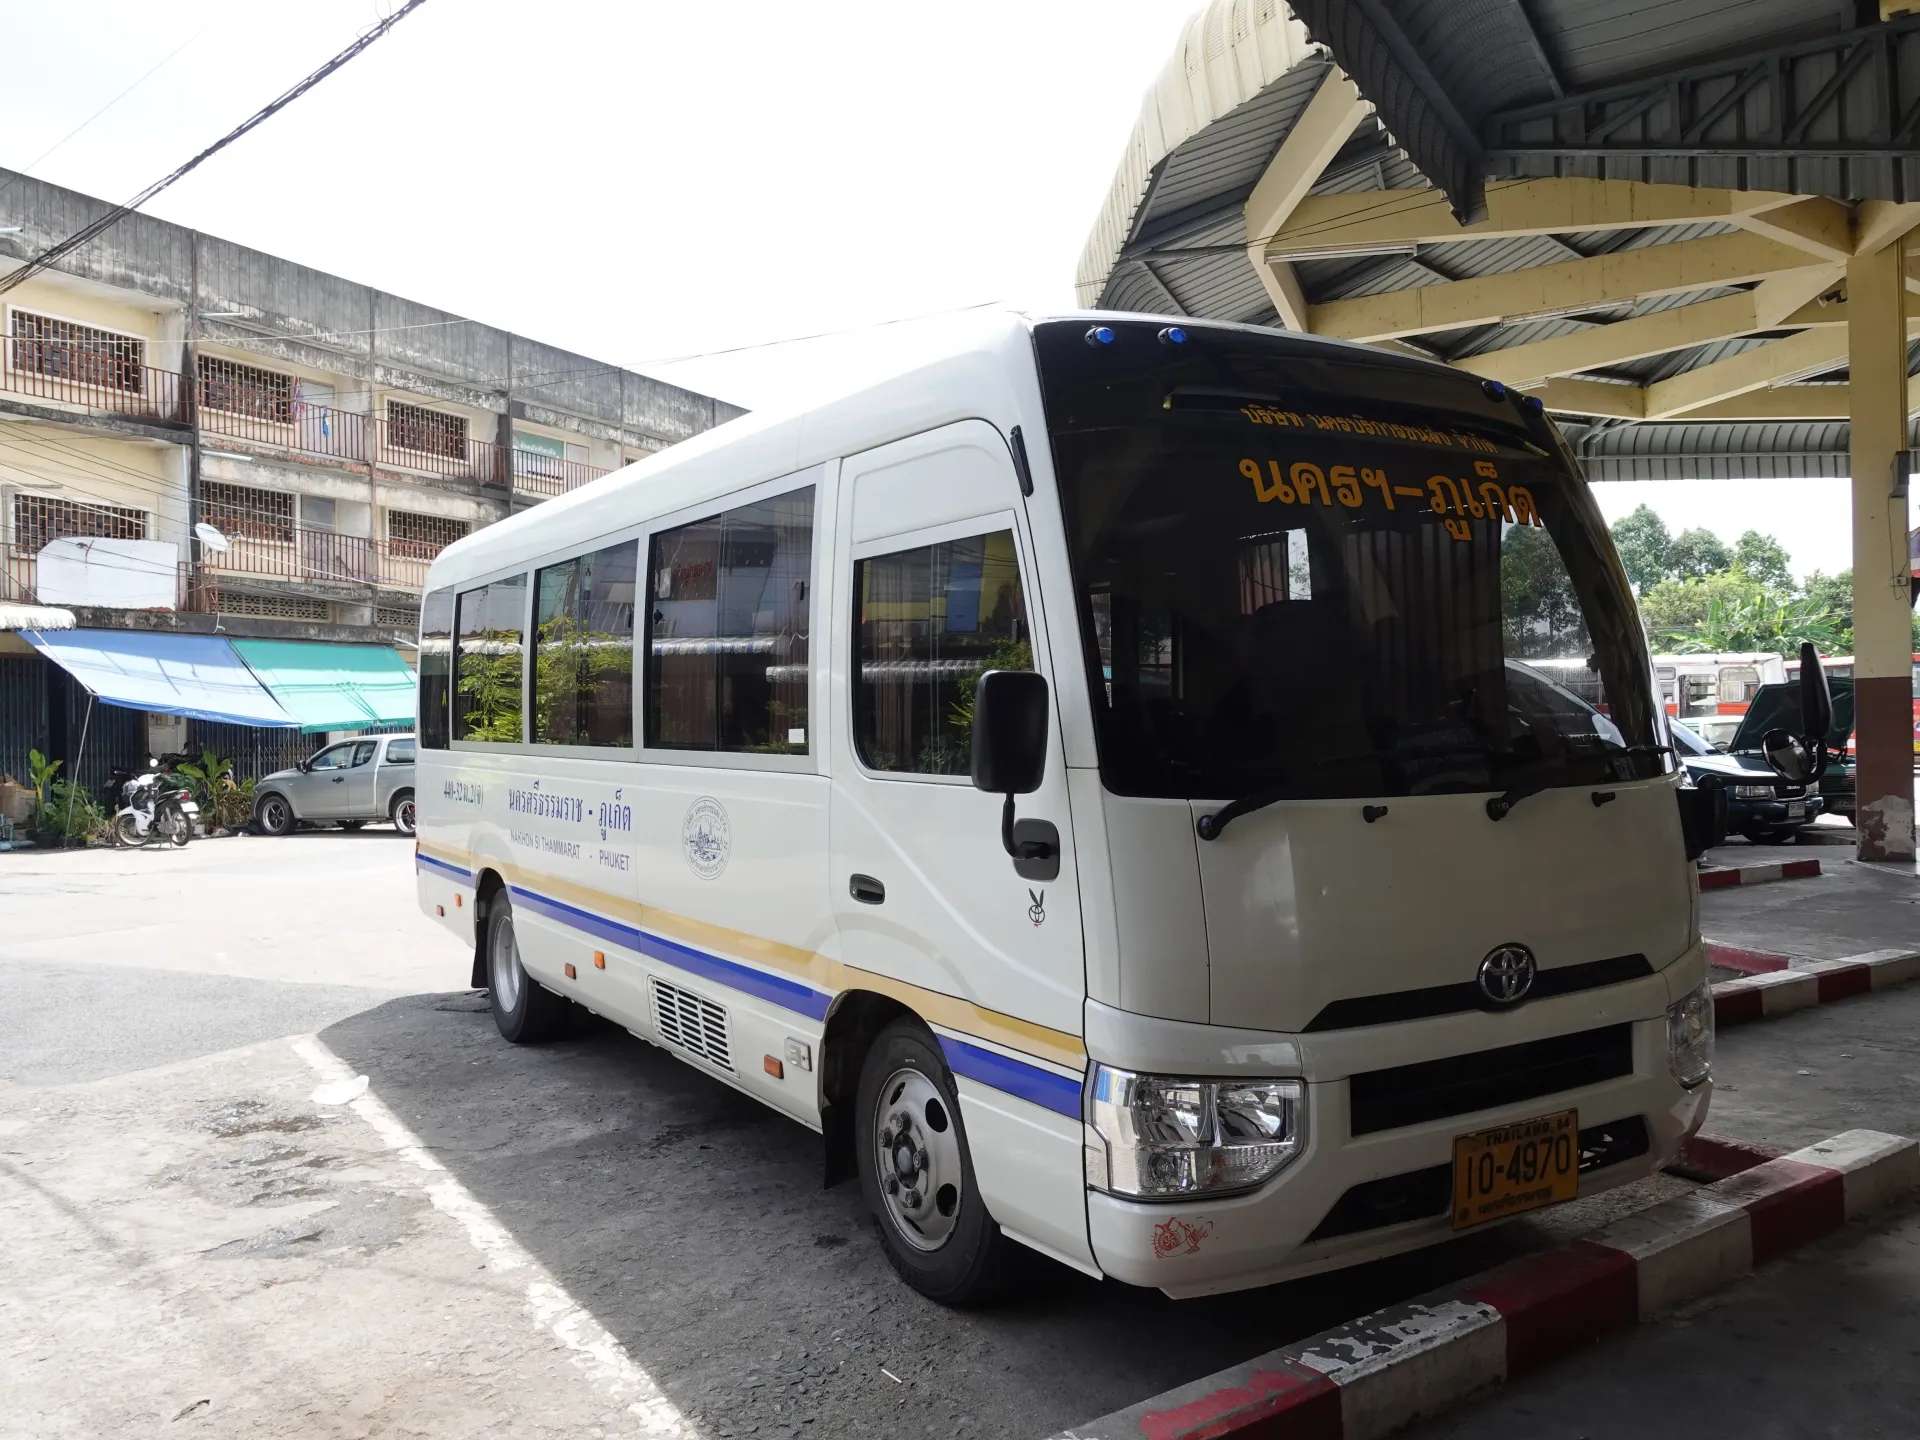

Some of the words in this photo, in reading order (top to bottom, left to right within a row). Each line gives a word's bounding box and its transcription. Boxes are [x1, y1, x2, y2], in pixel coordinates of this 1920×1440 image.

[1240, 403, 1305, 428] บริษัท
[509, 780, 583, 822] นครศรีธรรมราช
[598, 787, 631, 841] ภูเก็ต
[510, 829, 534, 847] NAKHON
[534, 835, 541, 850] SI
[541, 837, 580, 860] THAMMARAT
[599, 849, 630, 871] PHUKET
[1467, 1133, 1571, 1200] 10-4970
